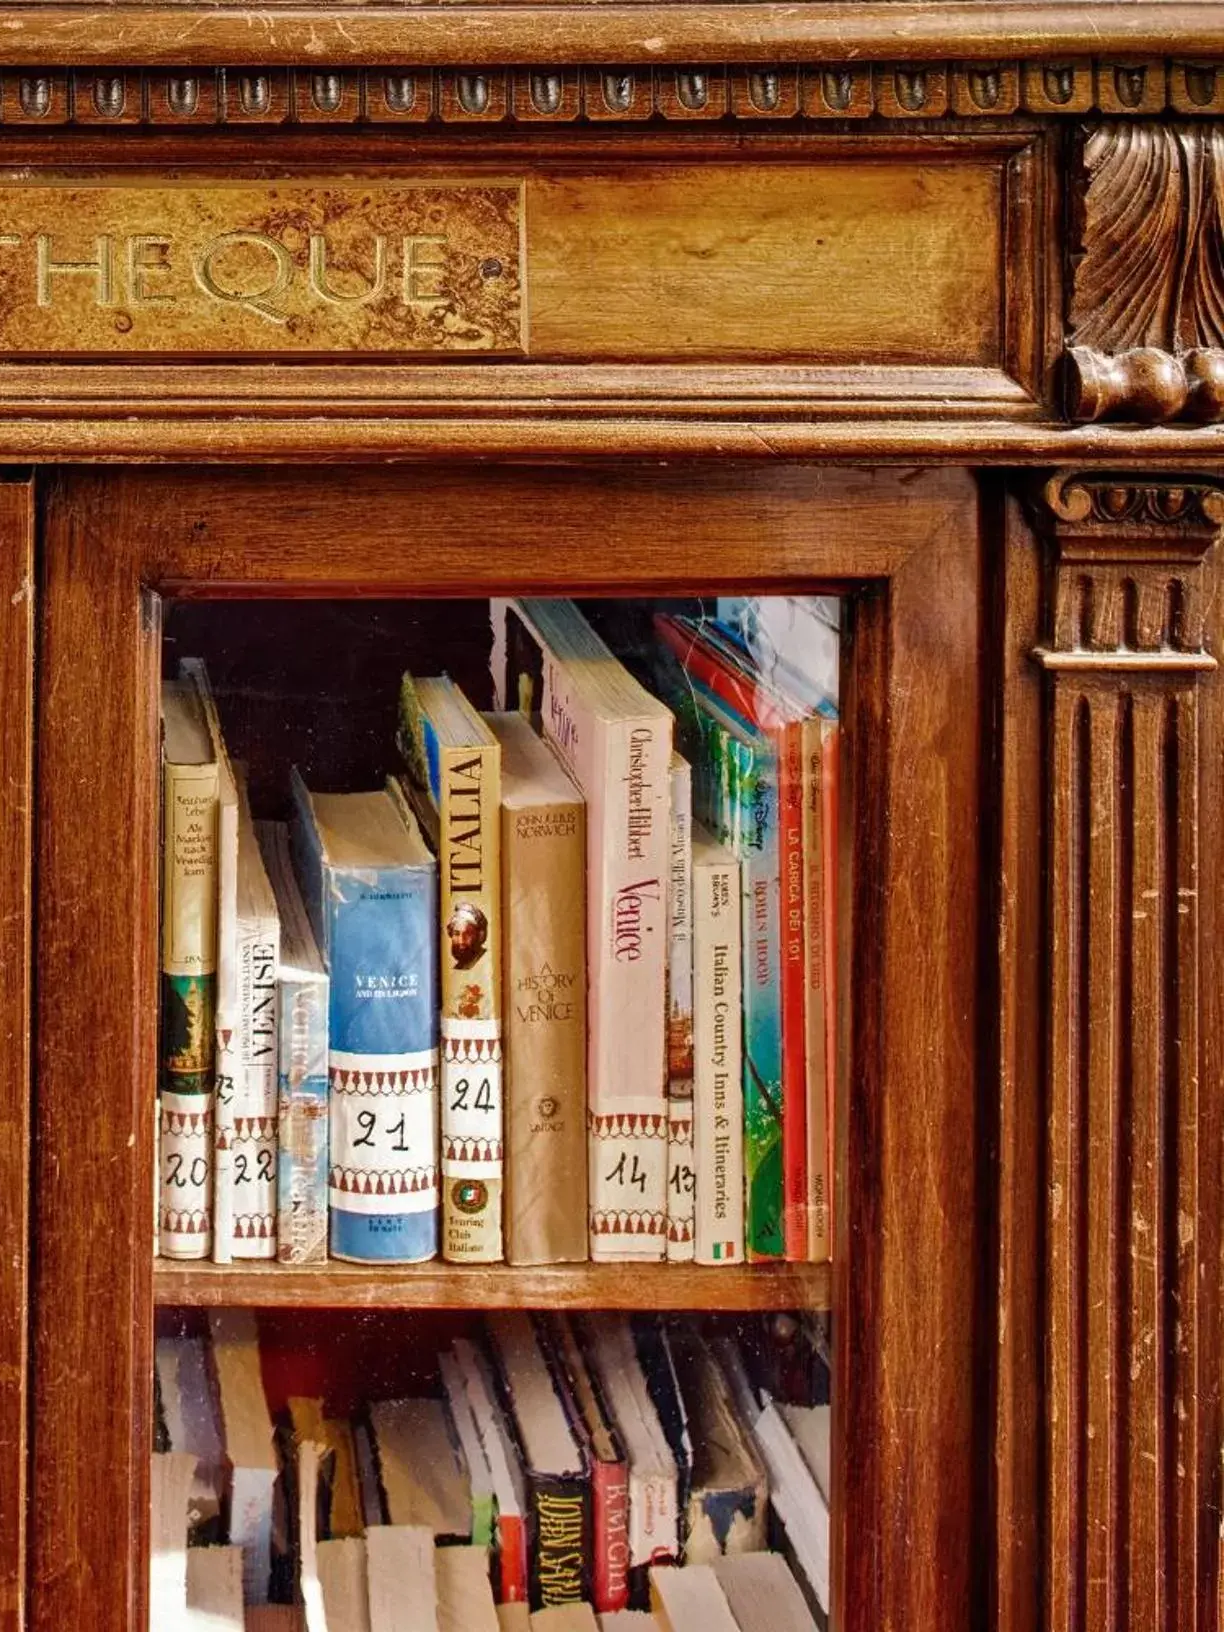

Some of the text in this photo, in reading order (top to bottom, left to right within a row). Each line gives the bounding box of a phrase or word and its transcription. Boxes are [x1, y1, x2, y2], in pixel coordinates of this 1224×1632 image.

[622, 728, 652, 861] Christopher Hibbert
[448, 755, 482, 896] ITALIA
[787, 828, 800, 961] LA CARICA DEI 101
[615, 878, 660, 963] Venice
[355, 974, 418, 989] VENICE
[517, 974, 576, 991] HISTORY
[755, 938, 770, 986] HOOD
[253, 944, 275, 1057] VENISE
[516, 1003, 574, 1023] VENICE
[450, 1078, 496, 1114] 24
[711, 944, 728, 1221] Italian Country Inns & Itineraries
[353, 1110, 409, 1151] 21
[166, 1153, 208, 1187] 20
[234, 1149, 276, 1186] 22
[605, 1152, 648, 1193] 14
[536, 1491, 584, 1549] JOHN
